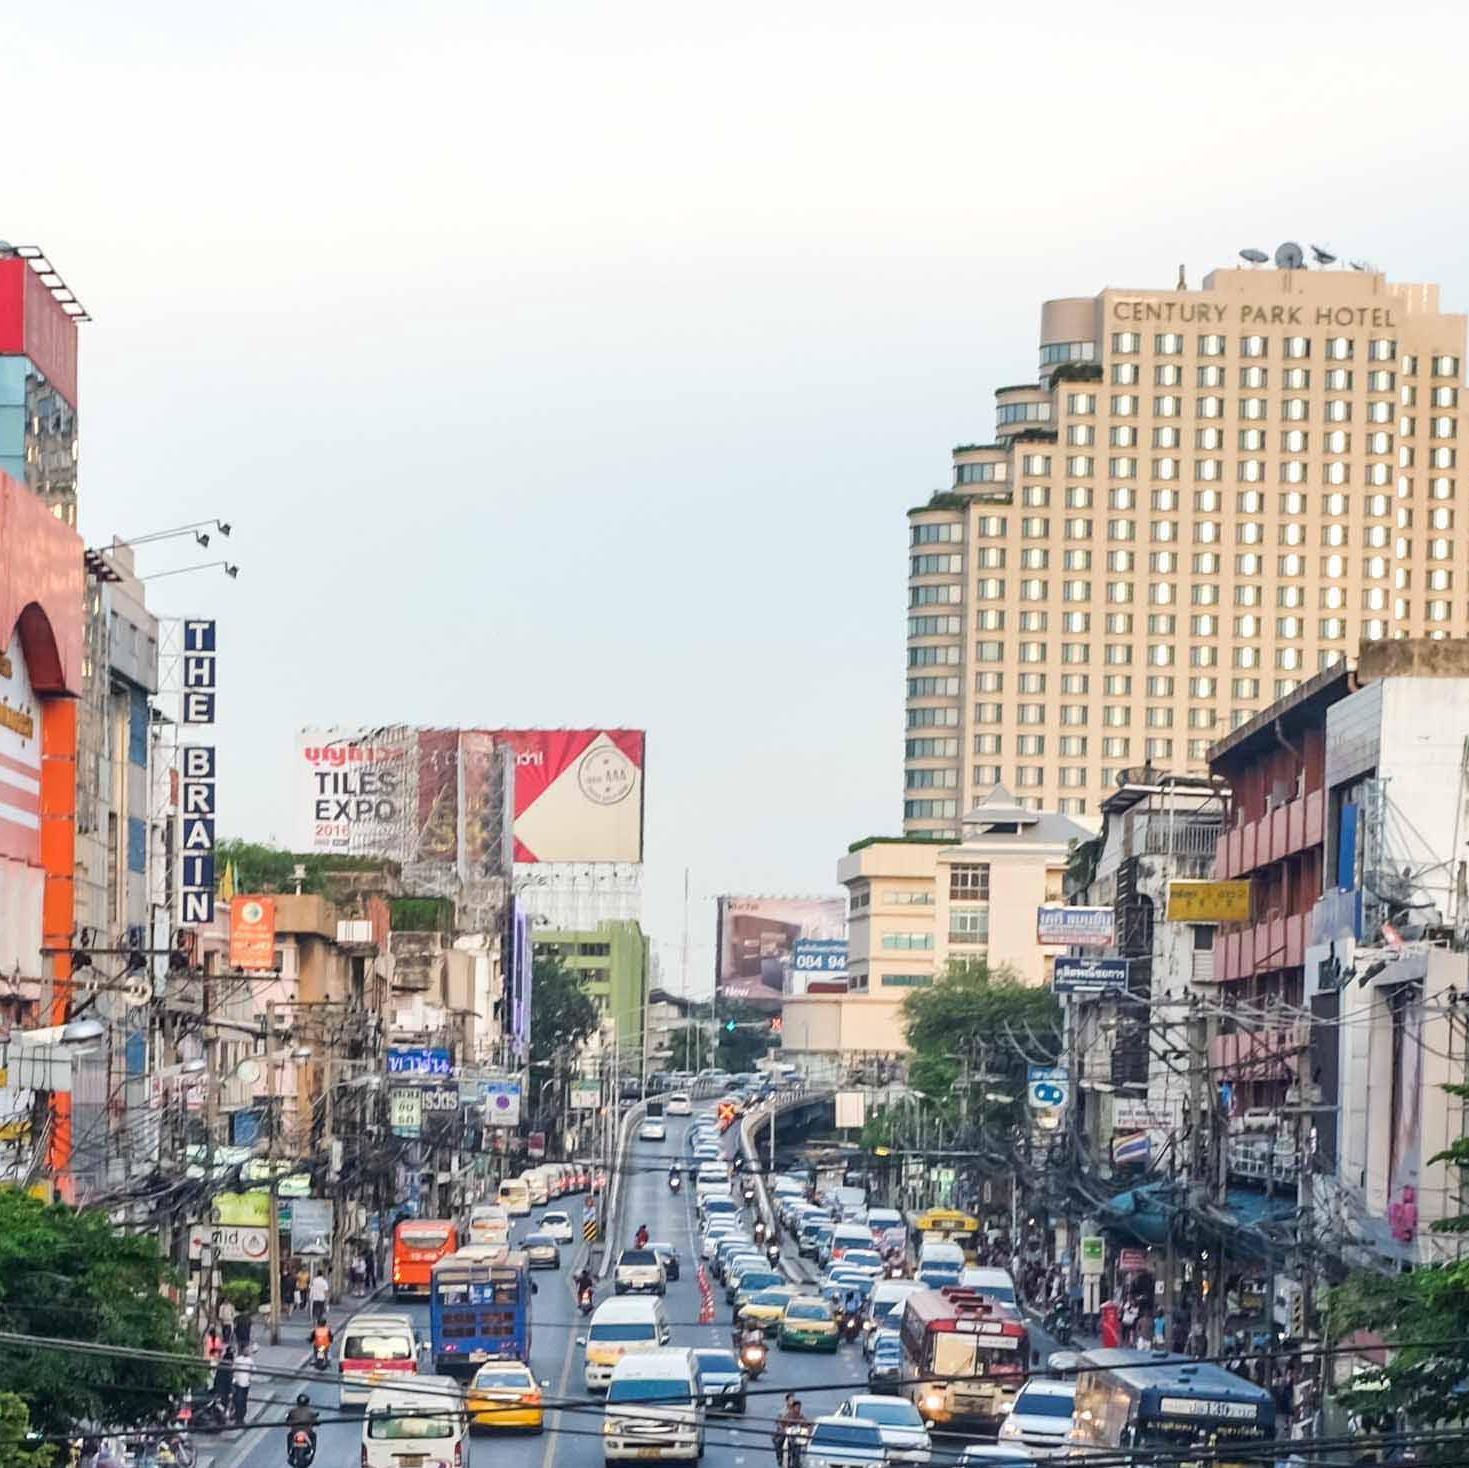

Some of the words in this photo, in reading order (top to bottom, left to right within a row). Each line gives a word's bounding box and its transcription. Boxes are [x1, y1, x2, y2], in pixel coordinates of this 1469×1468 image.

[1113, 301, 1229, 322] CENTURY
[1240, 304, 1304, 325] PARK
[1315, 306, 1396, 328] HOTEL
[187, 622, 211, 723] THE
[314, 771, 396, 796] TILES
[315, 799, 397, 822] EXPO
[185, 750, 213, 921] BRAIN
